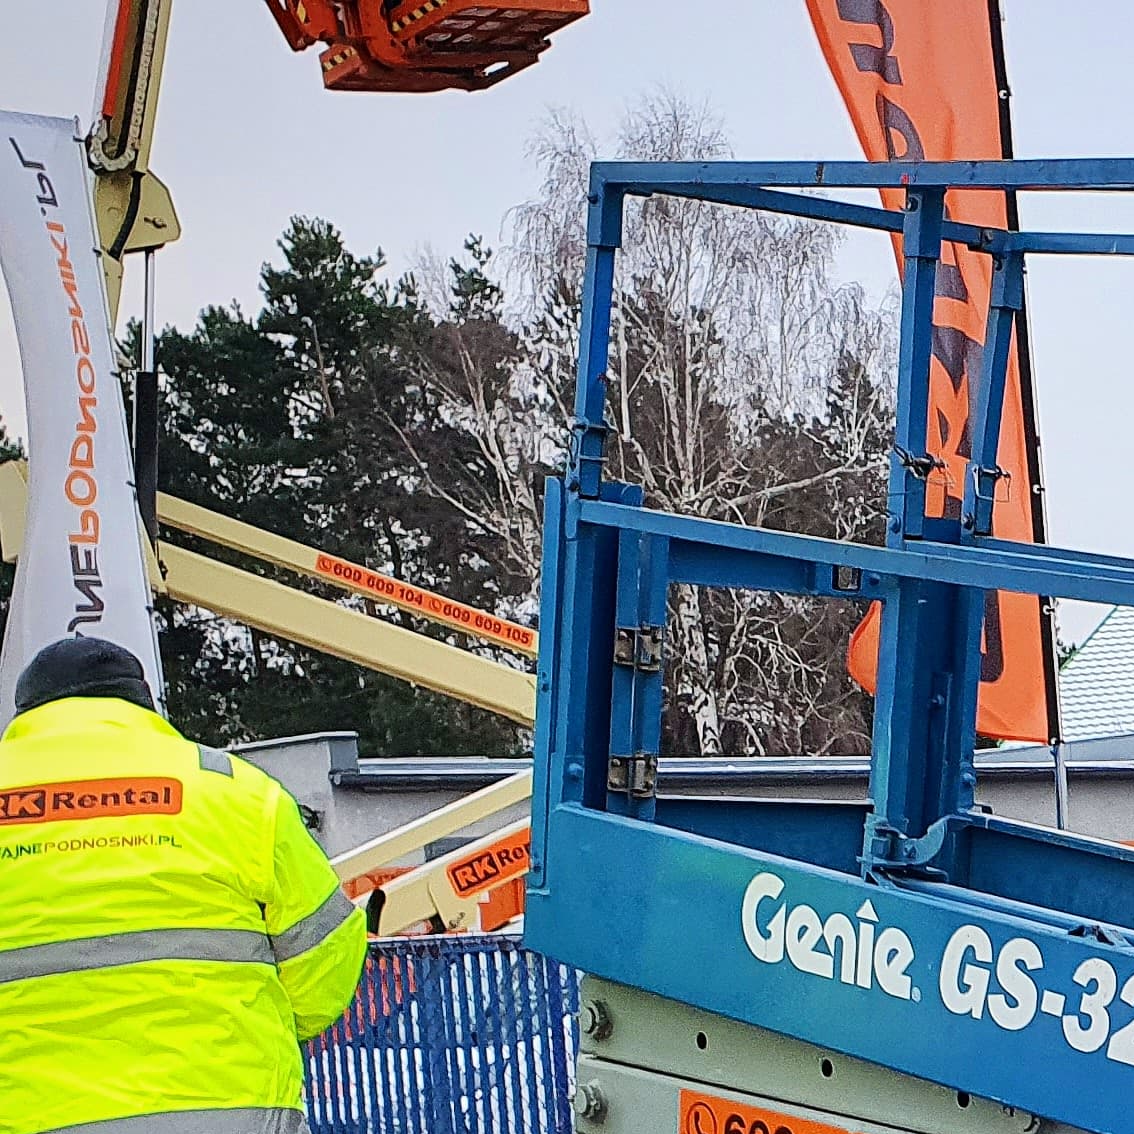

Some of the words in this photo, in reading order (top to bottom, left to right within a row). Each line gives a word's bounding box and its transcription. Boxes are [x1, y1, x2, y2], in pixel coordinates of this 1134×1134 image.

[400, 588, 423, 605] 104
[443, 604, 470, 622] 609
[475, 615, 501, 633] 609
[507, 628, 529, 644] 105
[53, 787, 171, 810] Rental
[0, 834, 182, 859] AJNEPODNOSNIKI.PL
[455, 855, 497, 889] RK
[741, 872, 915, 1001] Genie
